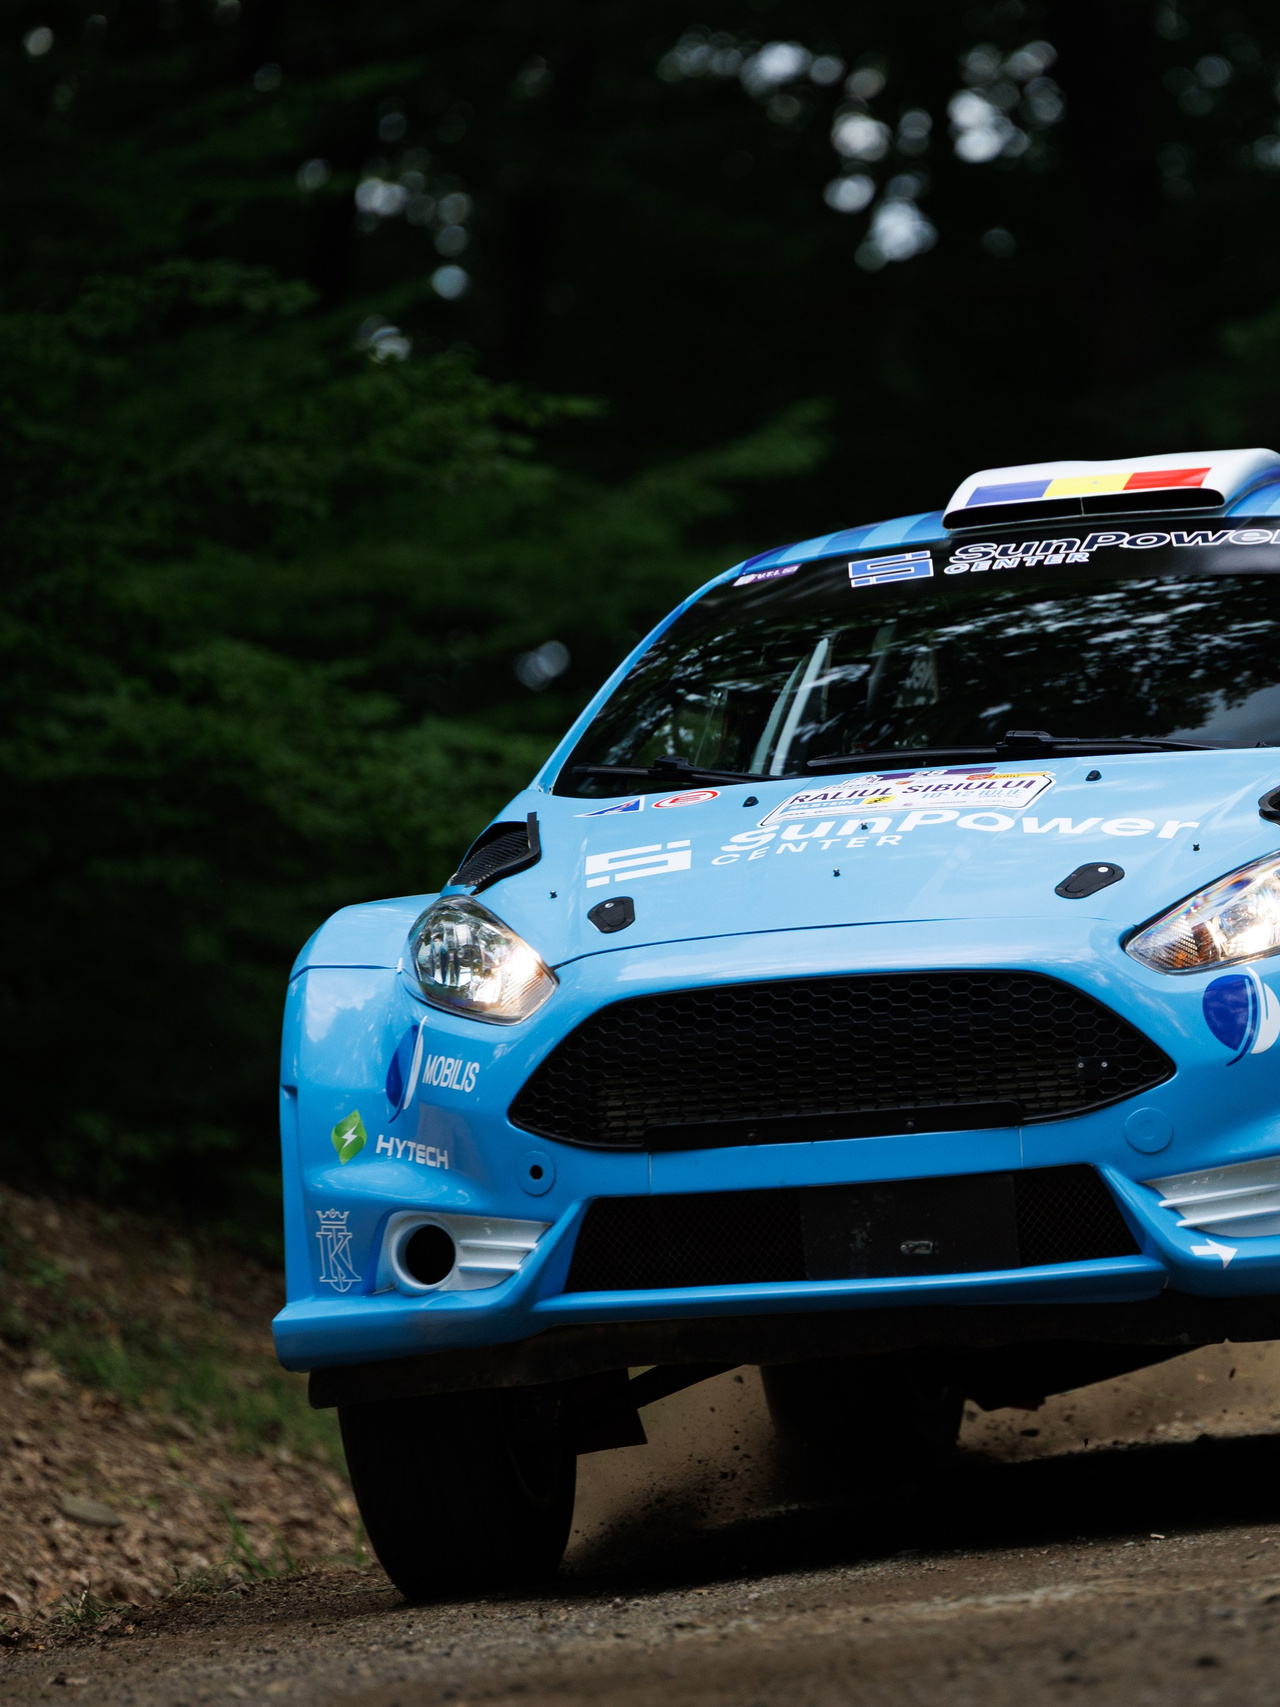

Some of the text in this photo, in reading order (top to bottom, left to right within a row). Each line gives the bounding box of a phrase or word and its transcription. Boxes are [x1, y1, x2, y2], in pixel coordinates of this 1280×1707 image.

[943, 552, 1090, 574] CENTER
[788, 787, 893, 805] RALIUL
[902, 779, 1037, 794] SIBIULUI
[788, 800, 856, 810] BILSTEIN
[720, 809, 1201, 851] SunPower
[711, 834, 902, 866] CENTER
[422, 1054, 480, 1093] MOBILIS
[375, 1134, 449, 1169] HYTECH
